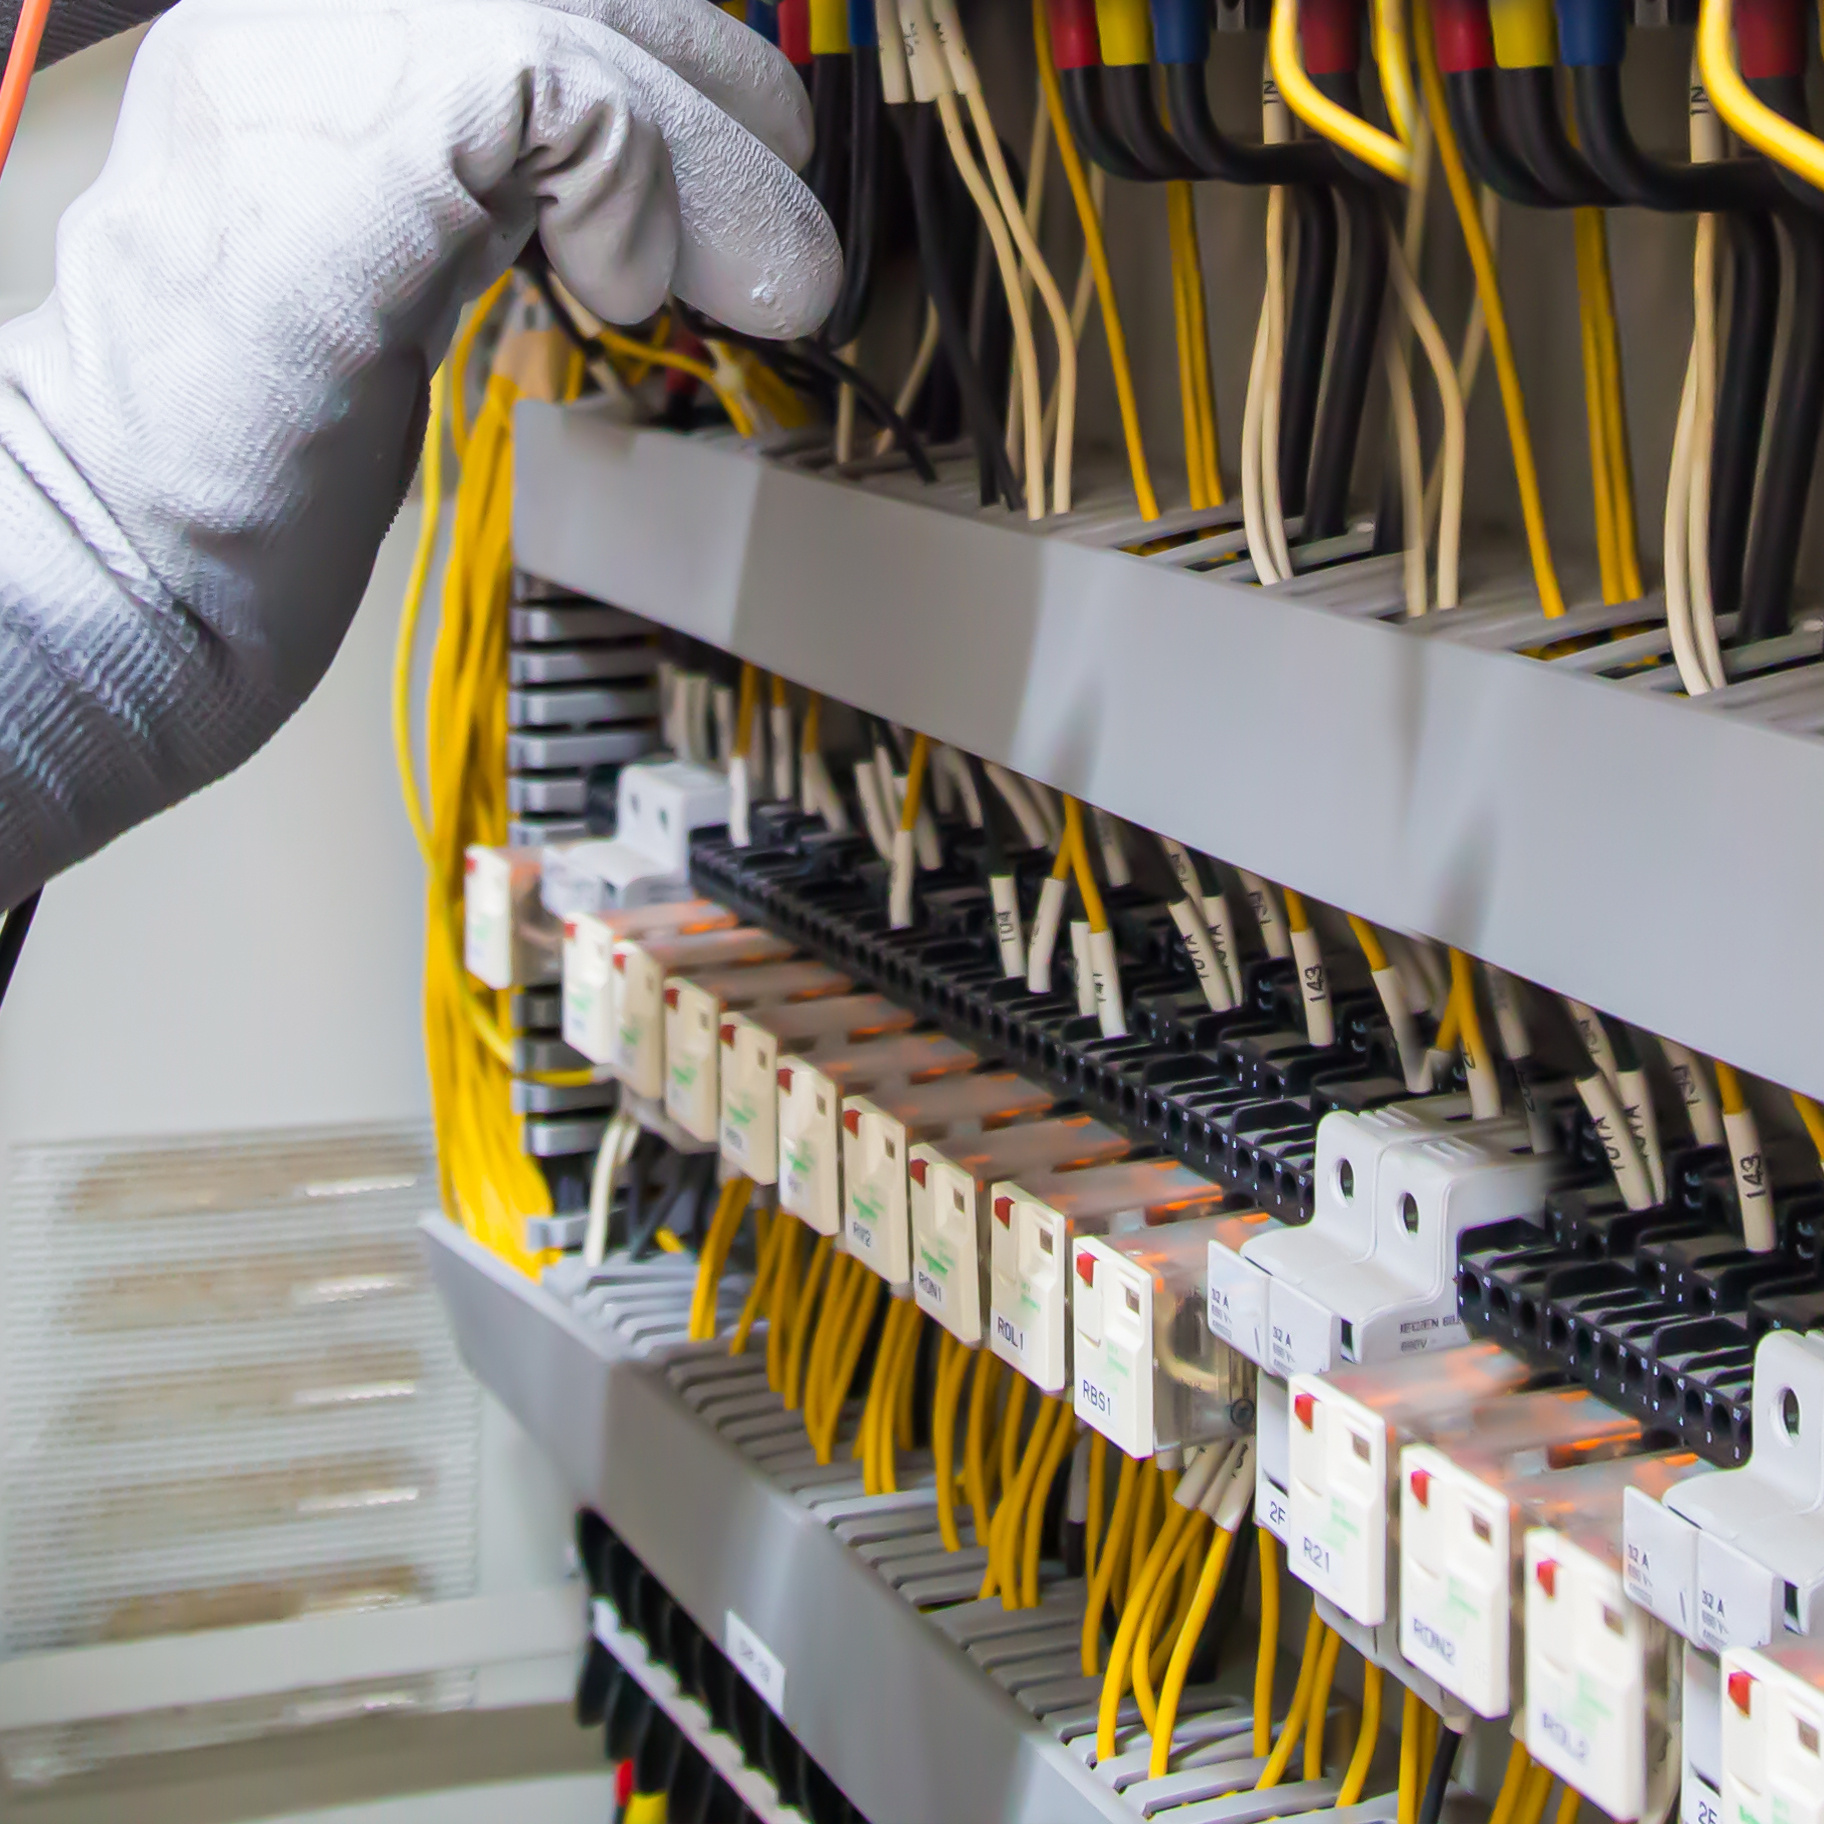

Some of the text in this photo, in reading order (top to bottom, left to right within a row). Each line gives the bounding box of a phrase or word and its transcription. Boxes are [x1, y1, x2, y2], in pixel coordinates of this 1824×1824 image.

[1304, 963, 1326, 1003] 143
[1740, 1152, 1767, 1199] 143
[1223, 1295, 1230, 1311] A
[1286, 1333, 1292, 1349] A
[1082, 1379, 1112, 1417] RBS1
[1269, 1501, 1286, 1525] 2F
[1303, 1535, 1331, 1574] R21
[1641, 1552, 1650, 1571] A
[1716, 1598, 1725, 1615] A
